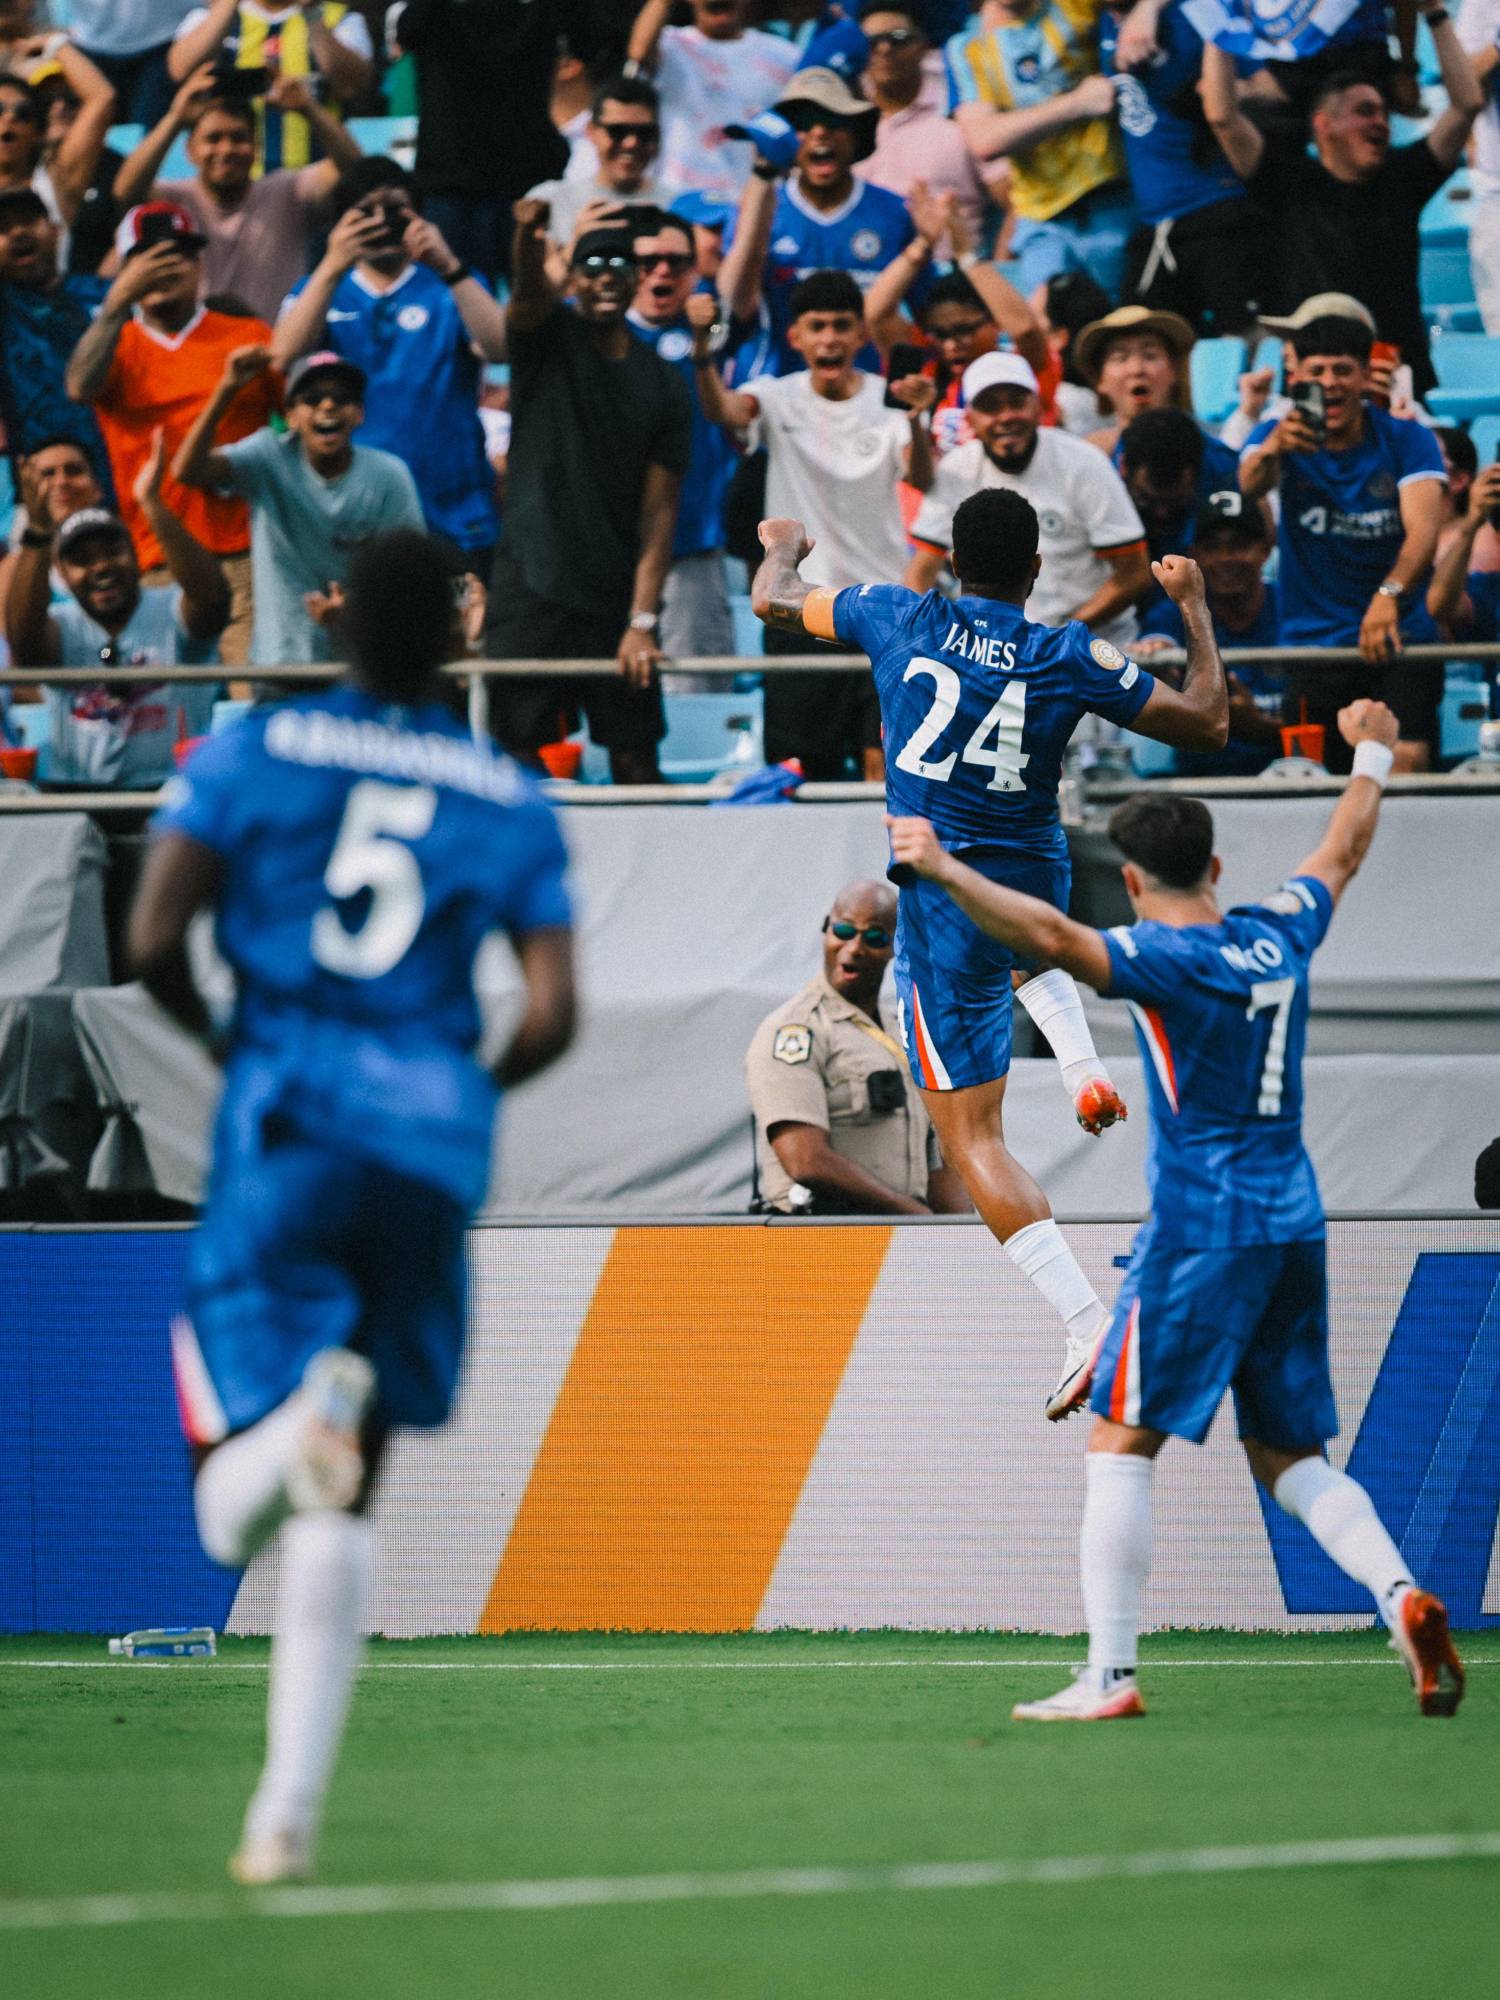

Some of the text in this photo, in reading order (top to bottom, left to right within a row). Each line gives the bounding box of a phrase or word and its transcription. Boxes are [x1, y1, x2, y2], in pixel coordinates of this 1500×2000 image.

[940, 622, 1017, 671] JAMES
[895, 656, 1031, 792] 24
[311, 778, 438, 981] 5
[1245, 976, 1295, 1116] 7
